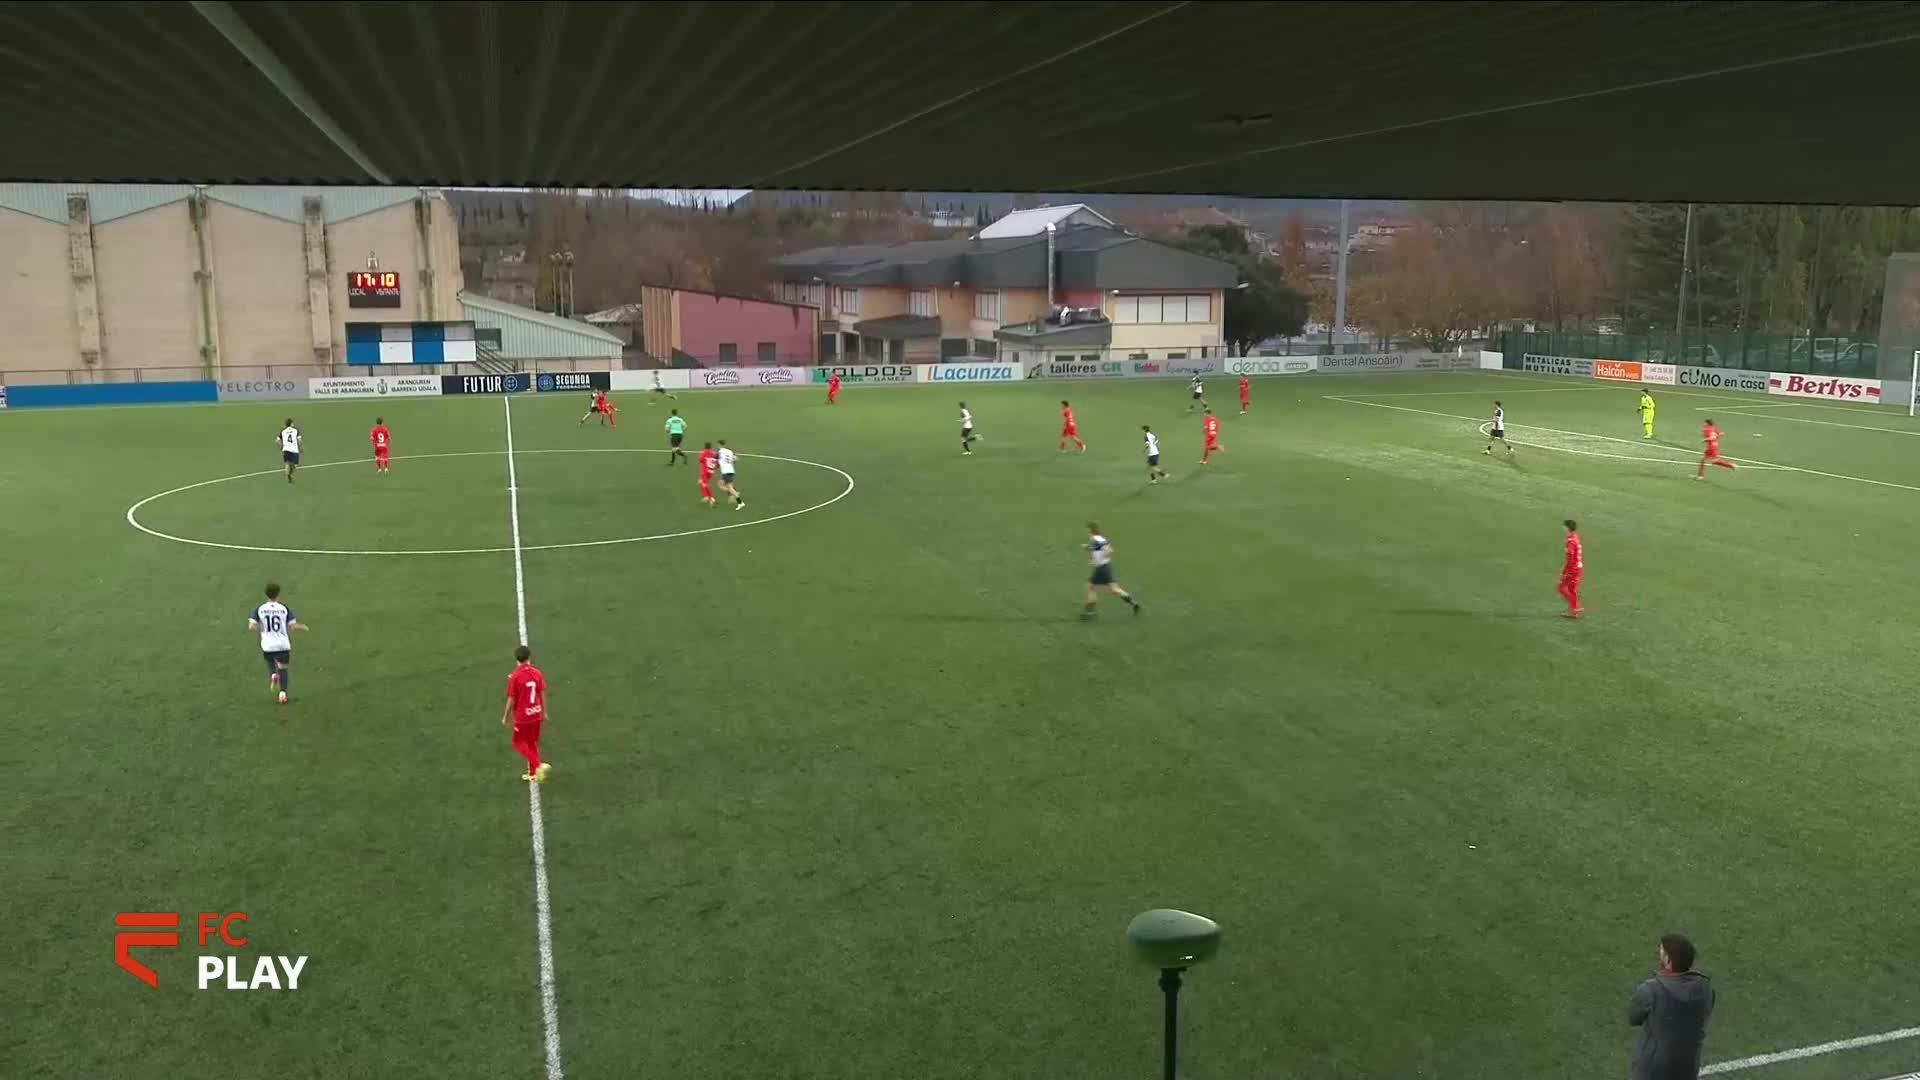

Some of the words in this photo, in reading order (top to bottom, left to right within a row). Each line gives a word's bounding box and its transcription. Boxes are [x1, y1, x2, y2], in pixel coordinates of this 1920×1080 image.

[349, 288, 366, 296] LOCAL
[1232, 361, 1279, 373] denda
[1323, 356, 1356, 367] Dental
[818, 366, 912, 378] TOLDOS
[932, 366, 1012, 380] Lacunza
[1050, 362, 1097, 374] talleres
[1525, 364, 1570, 374] MUTILVA
[555, 374, 590, 385] SEGUNDA
[1724, 378, 1737, 387] en
[1740, 379, 1765, 390] casa
[1786, 375, 1862, 398] Berlys
[287, 434, 293, 444] 4
[377, 432, 385, 443] 9
[265, 615, 280, 632] 16
[525, 680, 537, 704] 7
